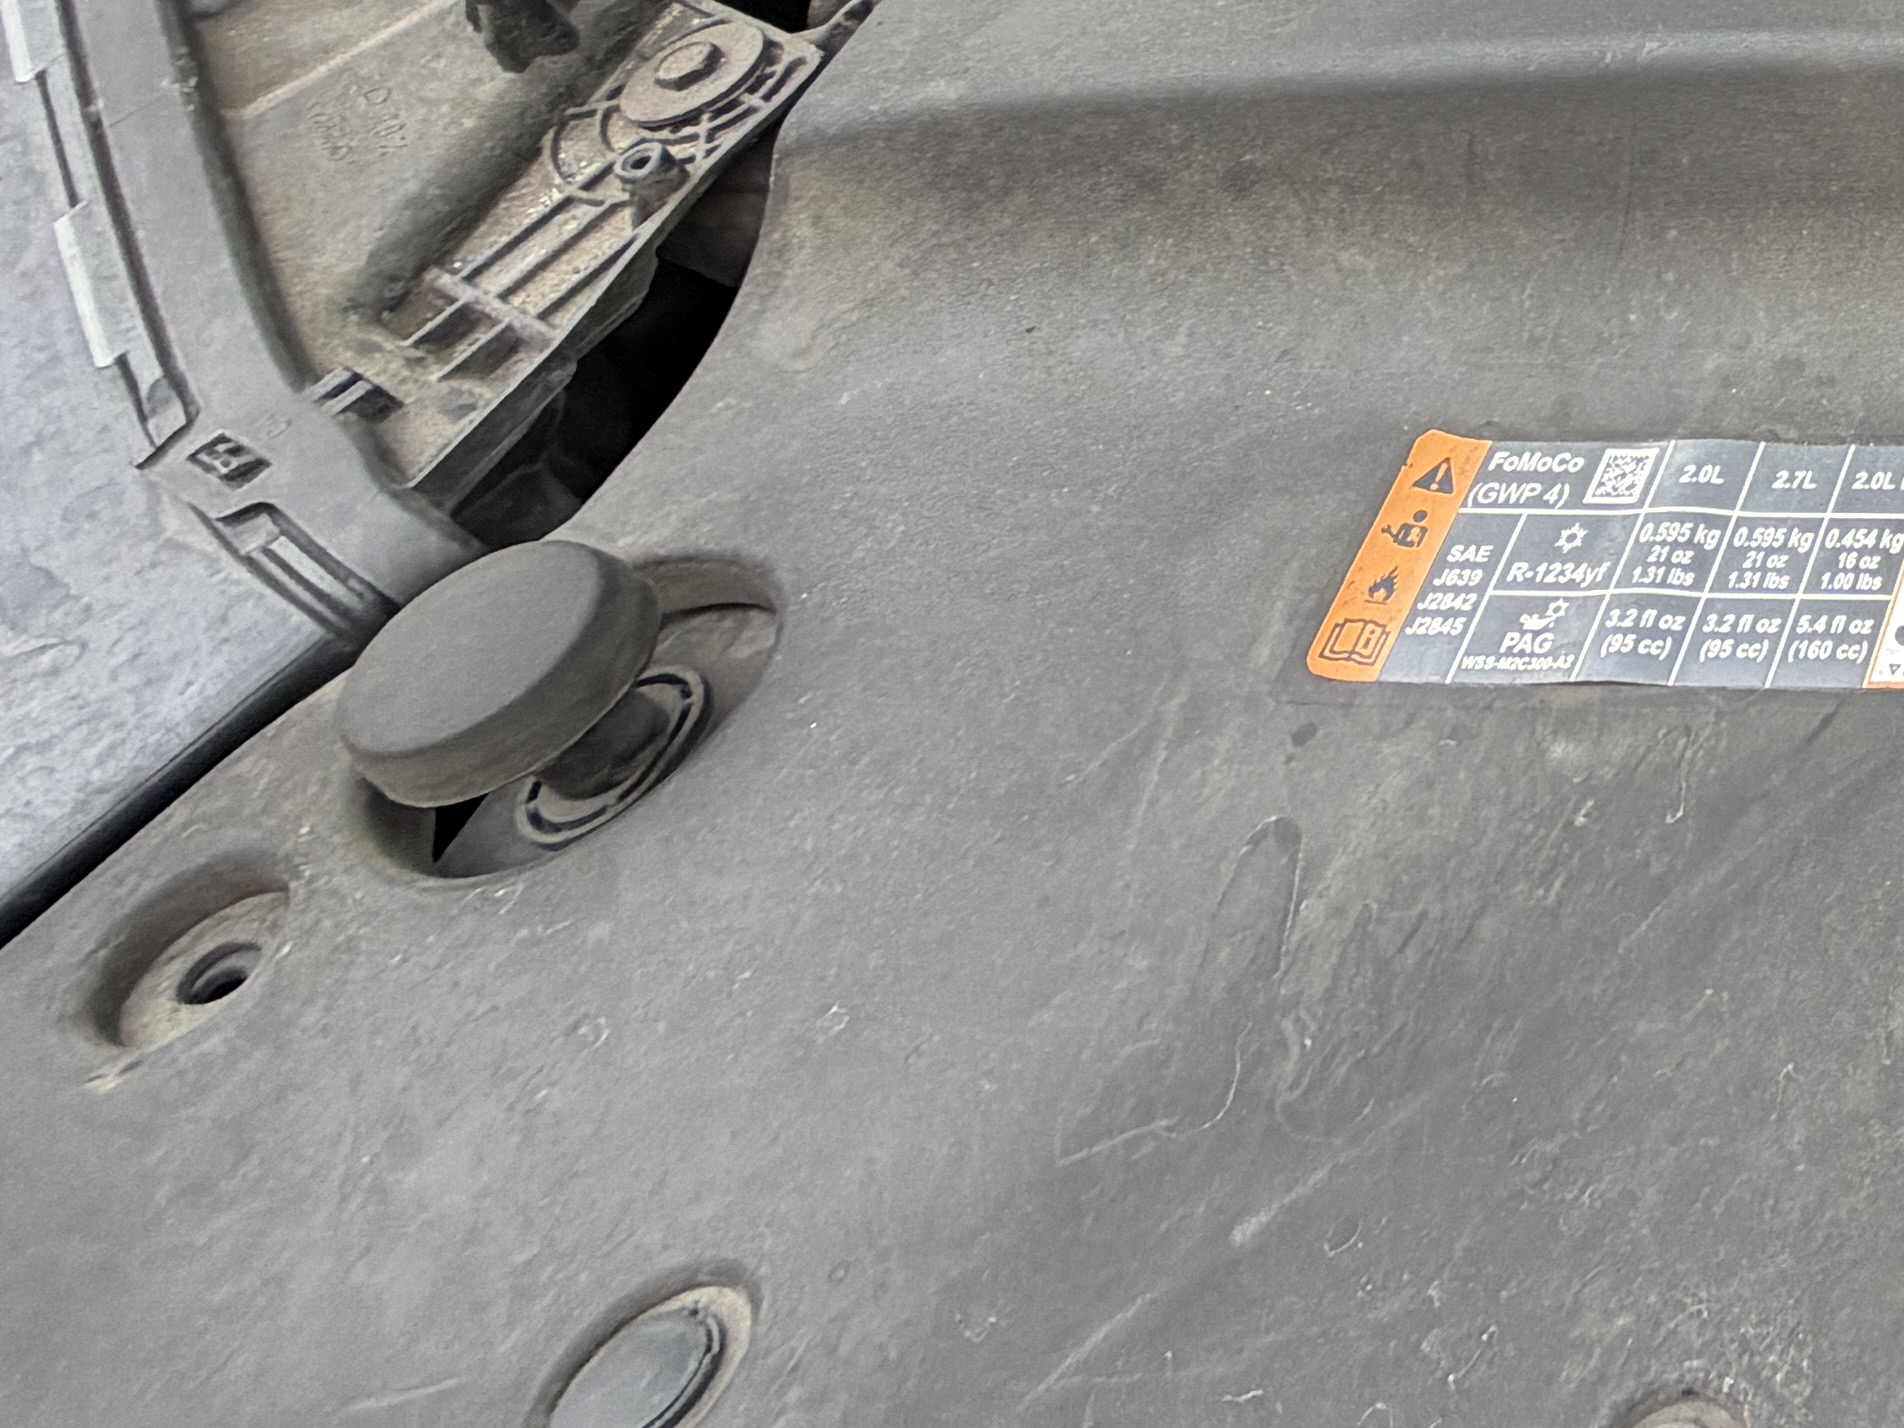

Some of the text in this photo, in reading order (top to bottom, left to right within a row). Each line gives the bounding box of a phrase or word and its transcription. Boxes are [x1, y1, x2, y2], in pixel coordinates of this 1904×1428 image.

[1488, 451, 1584, 473] FoMoCo
[1678, 464, 1724, 485] 2.0L
[1771, 471, 1817, 490] 2.7L
[1851, 472, 1896, 491] 2.0L
[1468, 482, 1570, 509] (GWP 4)
[1639, 521, 1721, 548] 0.595 kg
[1733, 526, 1815, 553] 0.595 kg
[1824, 527, 1880, 549] 0.454
[1446, 545, 1494, 563] SAE
[1646, 544, 1695, 565] 21 oz
[1742, 550, 1789, 569] 21 oz
[1838, 551, 1881, 570] 16 oz
[1433, 569, 1483, 587] J639
[1506, 562, 1611, 590] R-1234yf
[1632, 565, 1695, 586] 1.31 lbs
[1728, 571, 1790, 591] 1.31 lbs
[1821, 572, 1882, 591] 1.00 lbs
[1417, 593, 1476, 611] J2842
[1405, 616, 1467, 635] J2845
[1605, 608, 1637, 628] 3.2
[1658, 614, 1686, 632] oz
[1702, 614, 1735, 633] 3.2
[1755, 617, 1783, 634] oz
[1795, 615, 1828, 634] 5.4
[1849, 618, 1875, 635] oz
[1499, 632, 1555, 653] PAG
[1600, 634, 1672, 660] (95 cc)
[1699, 639, 1768, 663] (95 cc)
[1788, 639, 1869, 664] (160 cc)
